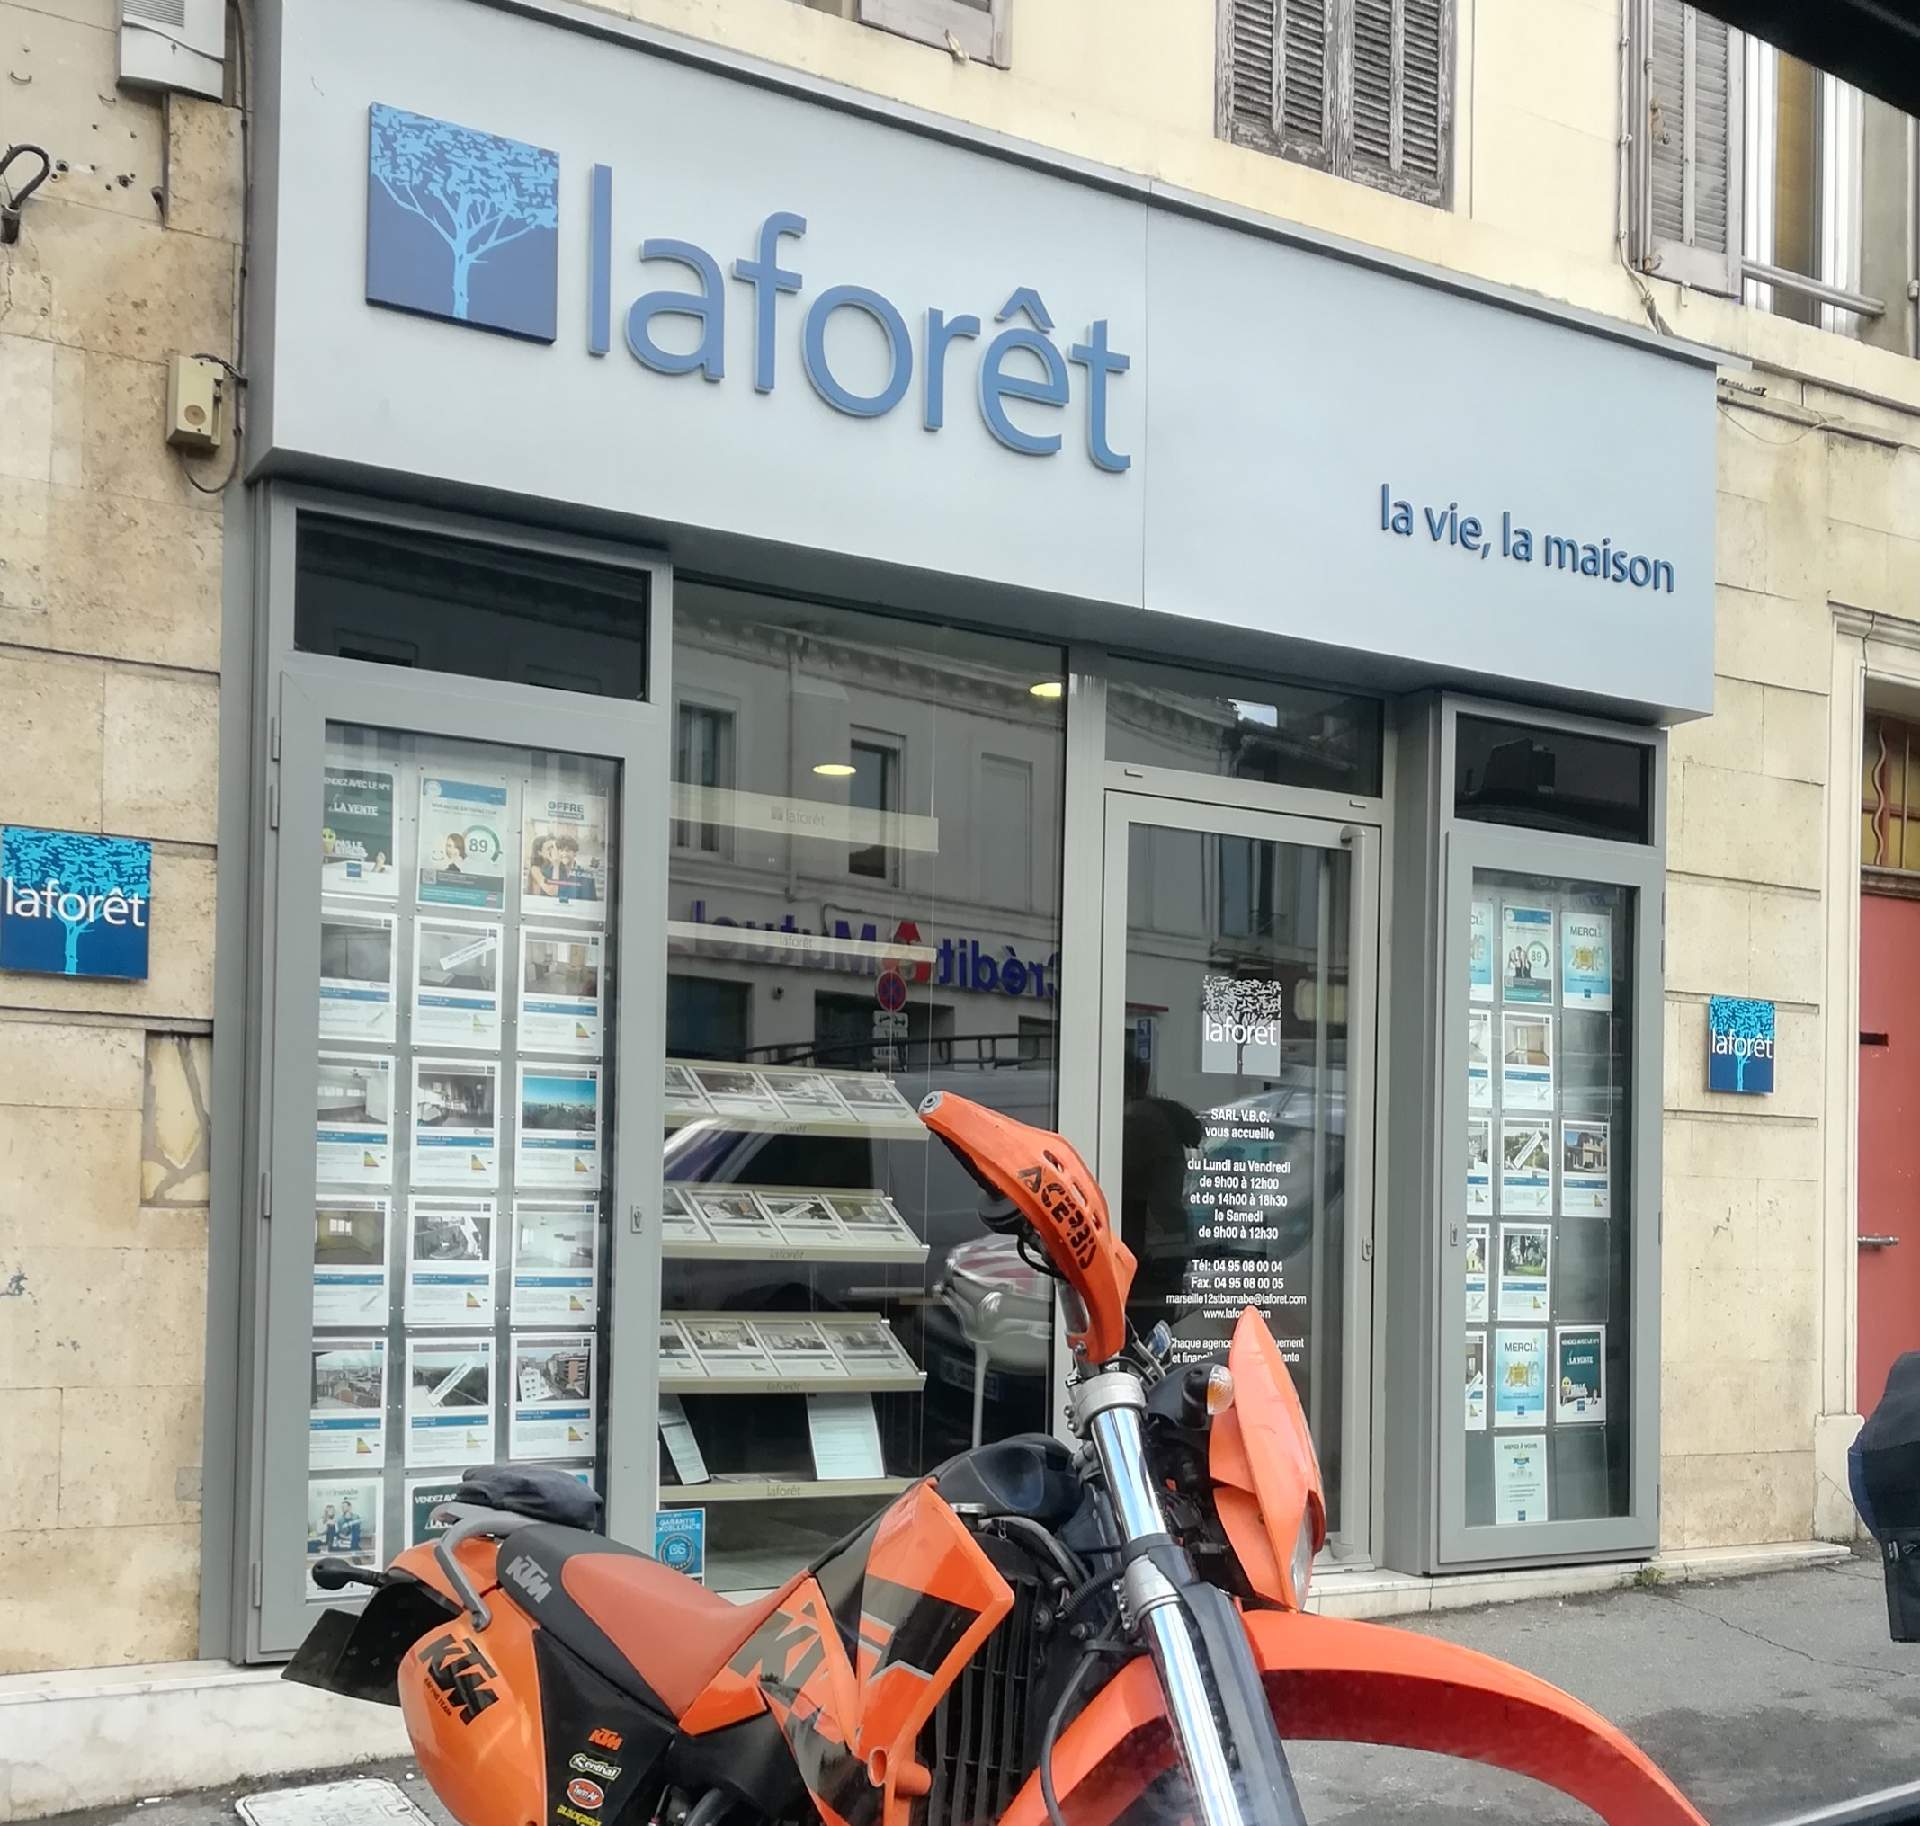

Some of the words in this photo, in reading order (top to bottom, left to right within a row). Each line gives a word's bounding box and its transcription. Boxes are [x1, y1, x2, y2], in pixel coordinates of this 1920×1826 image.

[586, 163, 1132, 472] laforêt
[1381, 483, 1414, 536] la
[1424, 501, 1491, 559] vie,
[1503, 511, 1533, 562] la
[1545, 537, 1674, 593] maison
[468, 837, 488, 854] 89
[5, 876, 146, 927] laforêt
[1570, 925, 1598, 938] MERCI
[1711, 1027, 1773, 1059] laforêt
[1210, 1108, 1239, 1122] SARL
[1241, 1109, 1270, 1123] V.B.C.
[1205, 1127, 1229, 1138] vous
[1231, 1127, 1275, 1140] accueille
[1187, 1159, 1201, 1170] du
[1203, 1159, 1231, 1172] Lundi
[1233, 1162, 1247, 1172] au
[1247, 1160, 1291, 1173] Vendredi
[1200, 1176, 1212, 1188] de
[1214, 1176, 1239, 1189] 9h00
[1241, 1176, 1248, 1189] à
[1250, 1177, 1279, 1190] 12h00
[1190, 1193, 1201, 1203] et
[1202, 1192, 1215, 1204] de
[1218, 1193, 1248, 1206] 14h00
[1249, 1193, 1256, 1206] à
[1214, 1209, 1224, 1222] le
[1226, 1209, 1264, 1223] Samedi
[1198, 1226, 1211, 1238] de
[1213, 1226, 1238, 1239] 9h00
[1240, 1225, 1247, 1239] à
[1249, 1227, 1279, 1240] 12h30
[1191, 1259, 1212, 1272] Tél:
[1213, 1260, 1226, 1272] 04
[1228, 1260, 1240, 1272] 95
[1242, 1260, 1255, 1272] 08
[1256, 1260, 1269, 1272] 00
[1271, 1260, 1283, 1272] 04
[1214, 1277, 1227, 1289] 04
[1228, 1277, 1241, 1289] 95
[1243, 1277, 1256, 1289] 08
[1257, 1277, 1270, 1289] 00
[1272, 1277, 1284, 1289] 05
[1504, 1341, 1533, 1353] MERCI
[506, 1556, 552, 1604] KTM
[418, 1634, 499, 1726] KTM
[588, 1728, 623, 1751] KTM
